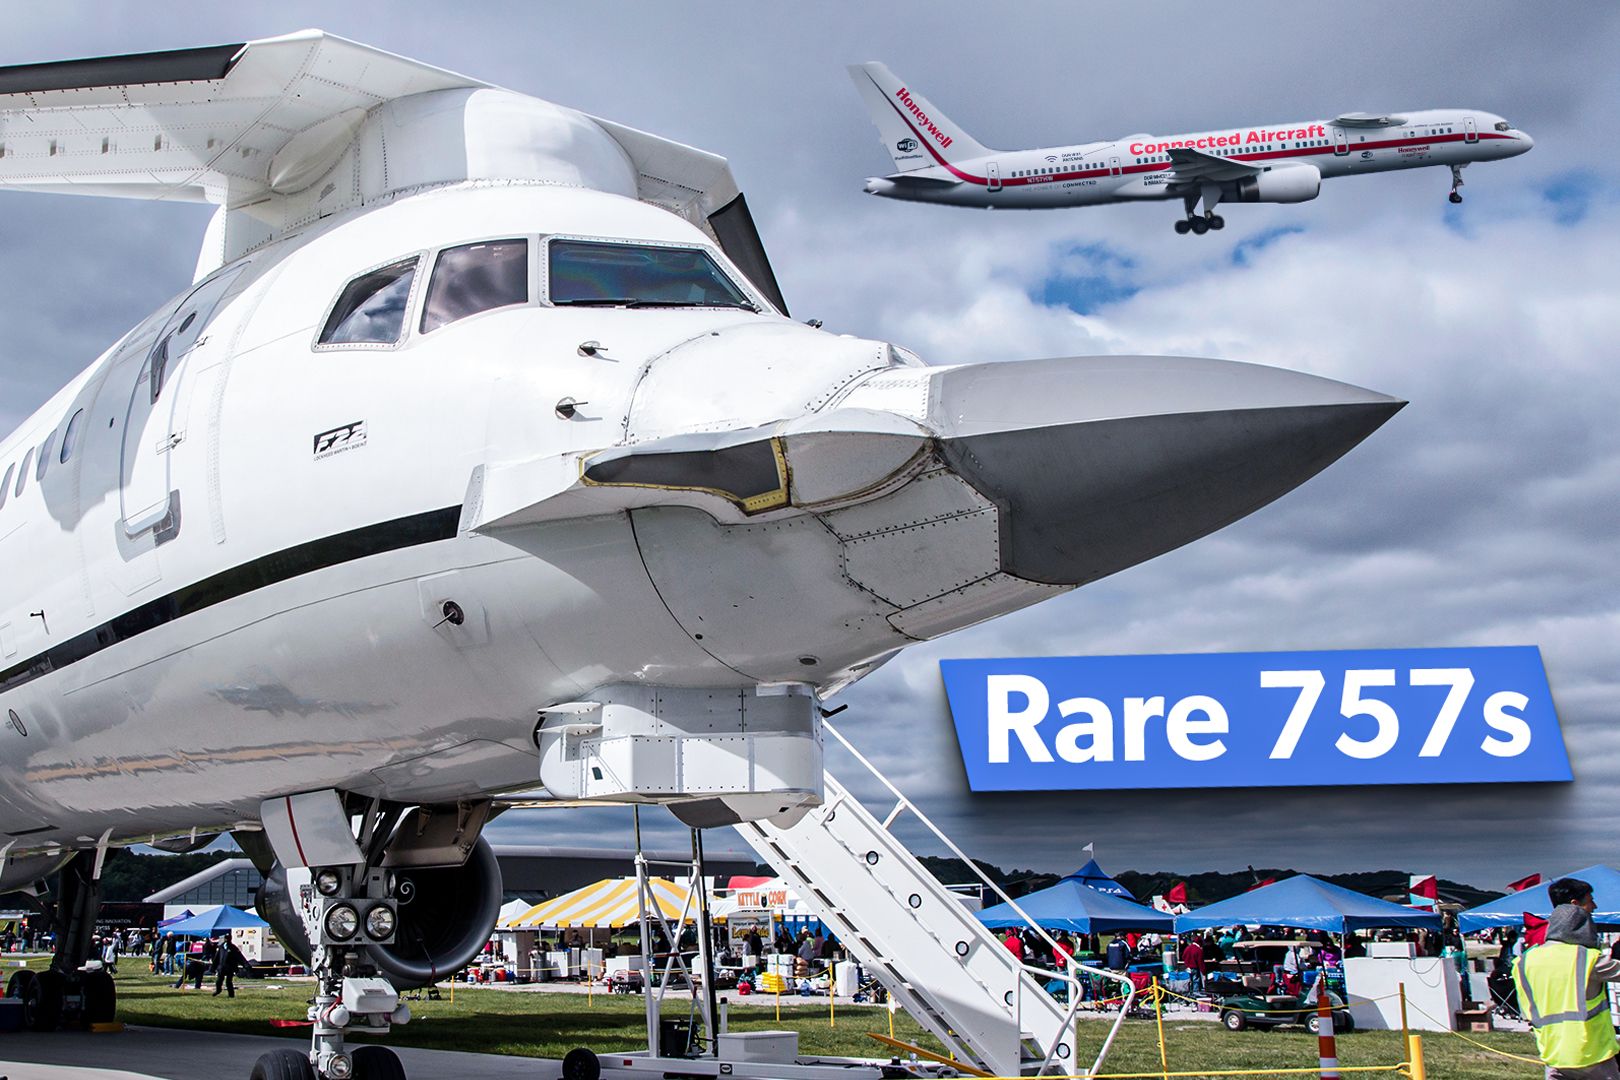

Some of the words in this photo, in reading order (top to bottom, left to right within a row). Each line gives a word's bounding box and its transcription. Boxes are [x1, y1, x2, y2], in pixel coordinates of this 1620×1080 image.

[895, 87, 953, 149] Honeywell
[1129, 133, 1241, 156] Connected
[1245, 125, 1326, 144] Aircraft
[1398, 145, 1430, 153] Honeywell
[1062, 180, 1097, 189] CONNECTED
[737, 891, 760, 907] KETTLE
[768, 890, 787, 905] CORN
